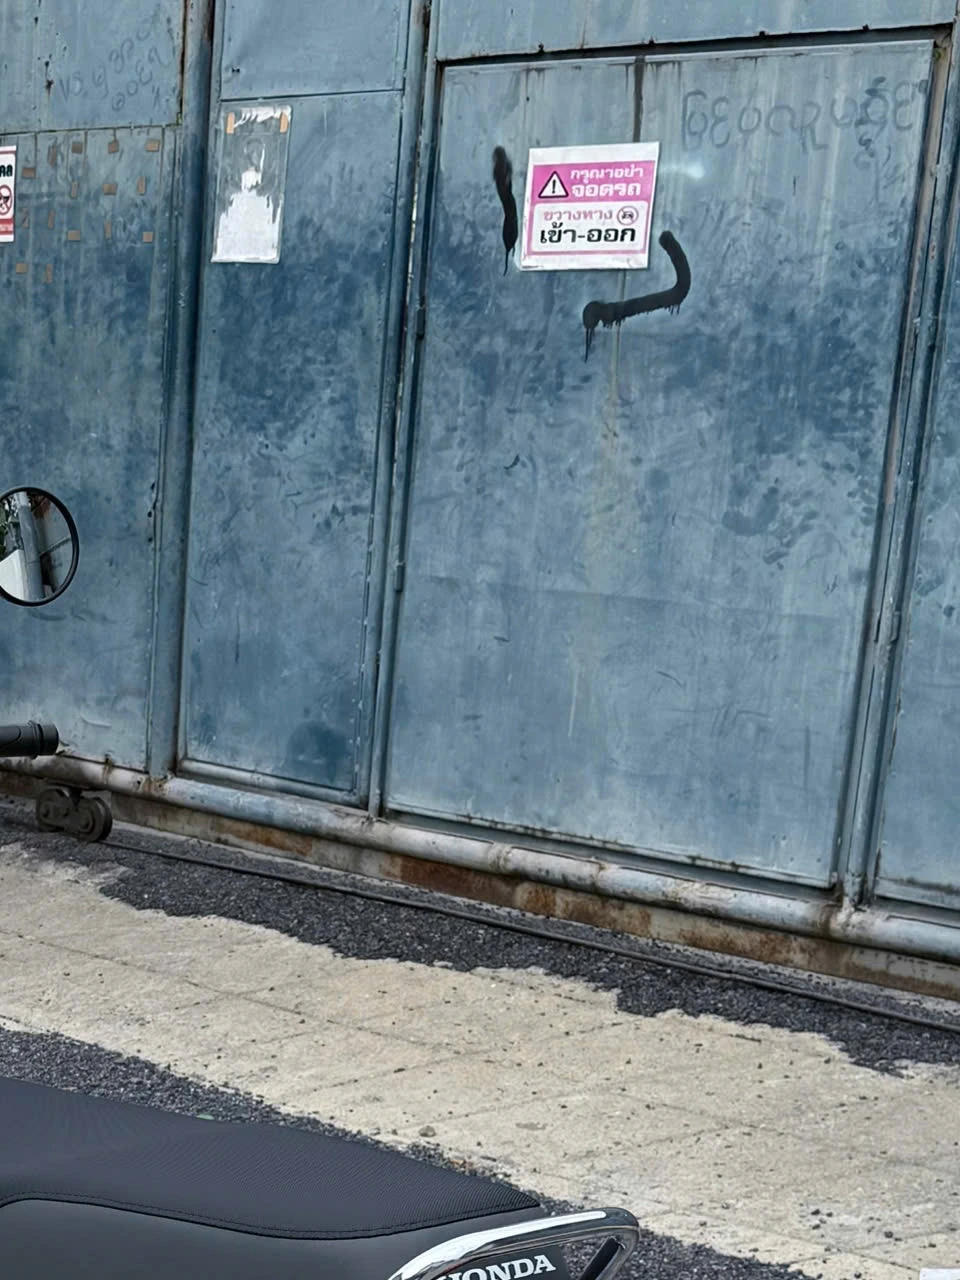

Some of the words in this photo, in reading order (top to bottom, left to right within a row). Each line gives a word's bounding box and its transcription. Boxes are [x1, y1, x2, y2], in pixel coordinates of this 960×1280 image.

[570, 164, 644, 184] กรุณาอย่า
[571, 182, 641, 198] จอดรถ
[543, 208, 613, 222] ขวางทาง
[540, 222, 636, 244] เข้า-ออก
